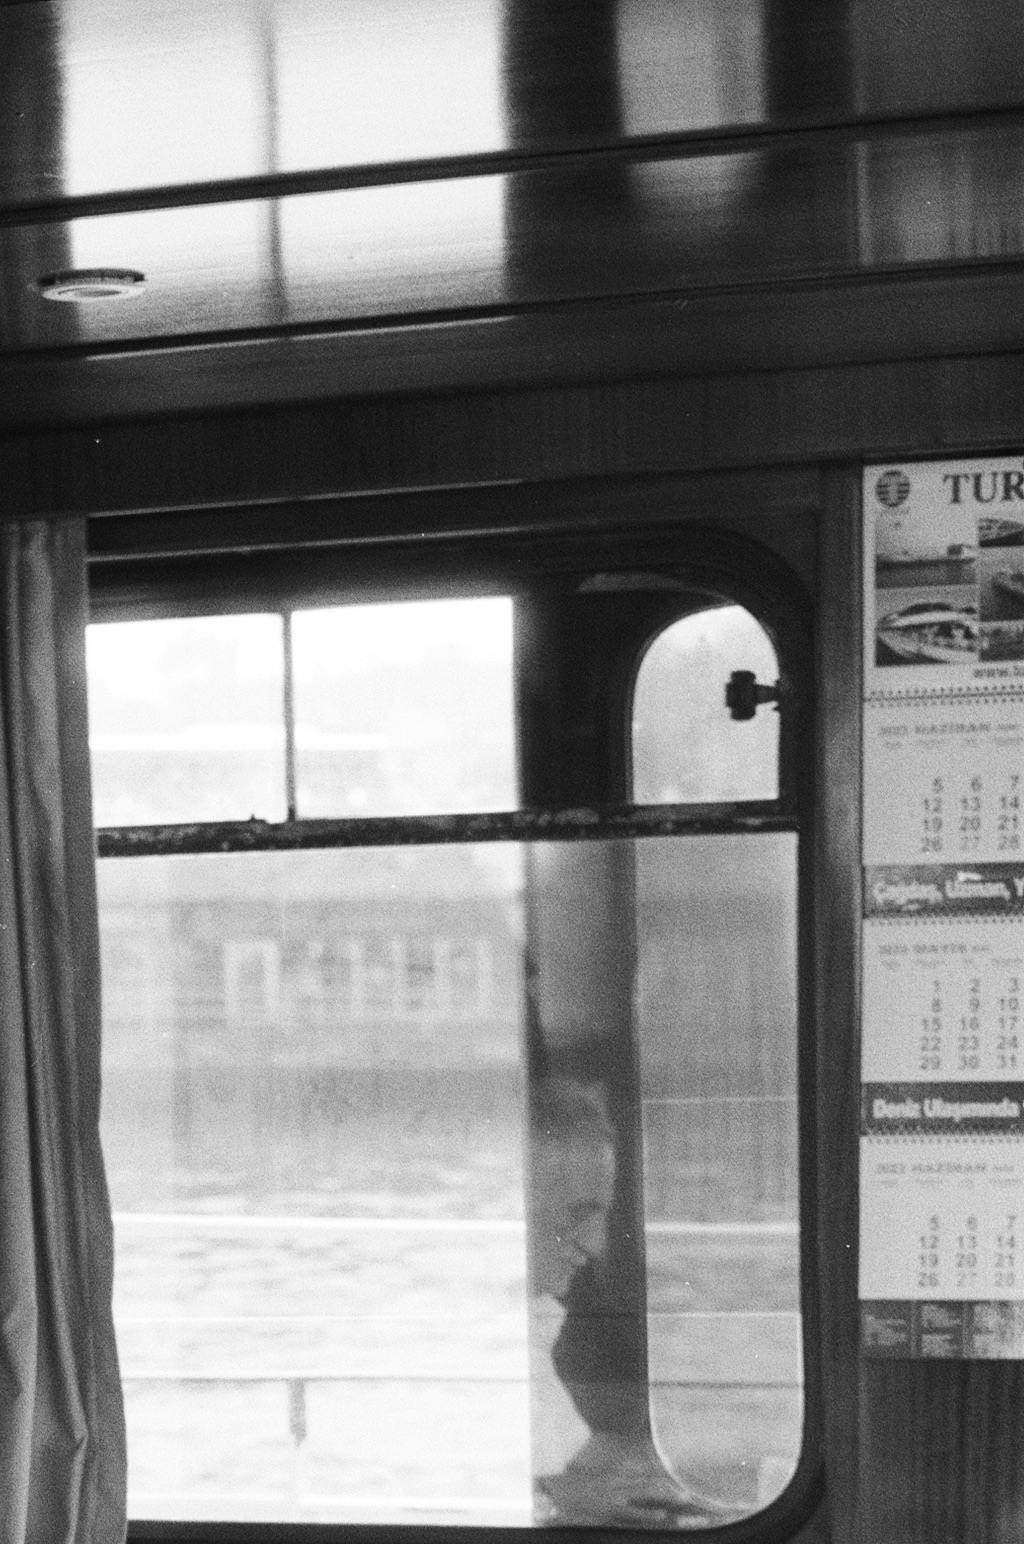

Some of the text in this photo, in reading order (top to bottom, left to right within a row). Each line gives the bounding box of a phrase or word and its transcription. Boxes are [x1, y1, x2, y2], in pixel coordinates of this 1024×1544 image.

[932, 774, 1020, 793] 5 6 7
[923, 795, 1020, 813] 12 13 14
[923, 814, 1019, 833] 19 20 21
[921, 836, 943, 852] 26
[998, 834, 1020, 850] 28
[969, 978, 981, 994] 2
[1008, 977, 1019, 993] 3
[931, 997, 1019, 1013] 8 9 10
[921, 1016, 1018, 1032] 15 16 17
[920, 1035, 1018, 1051] 22 23 24
[919, 1054, 1017, 1070] 29 30 31
[873, 1098, 921, 1118] Deniz
[929, 1214, 1017, 1232] 5 6 7
[919, 1235, 1016, 1250] 12 13 14
[919, 1252, 1015, 1268] 19 20 21
[918, 1271, 939, 1288] 26
[994, 1270, 1015, 1287] 28
